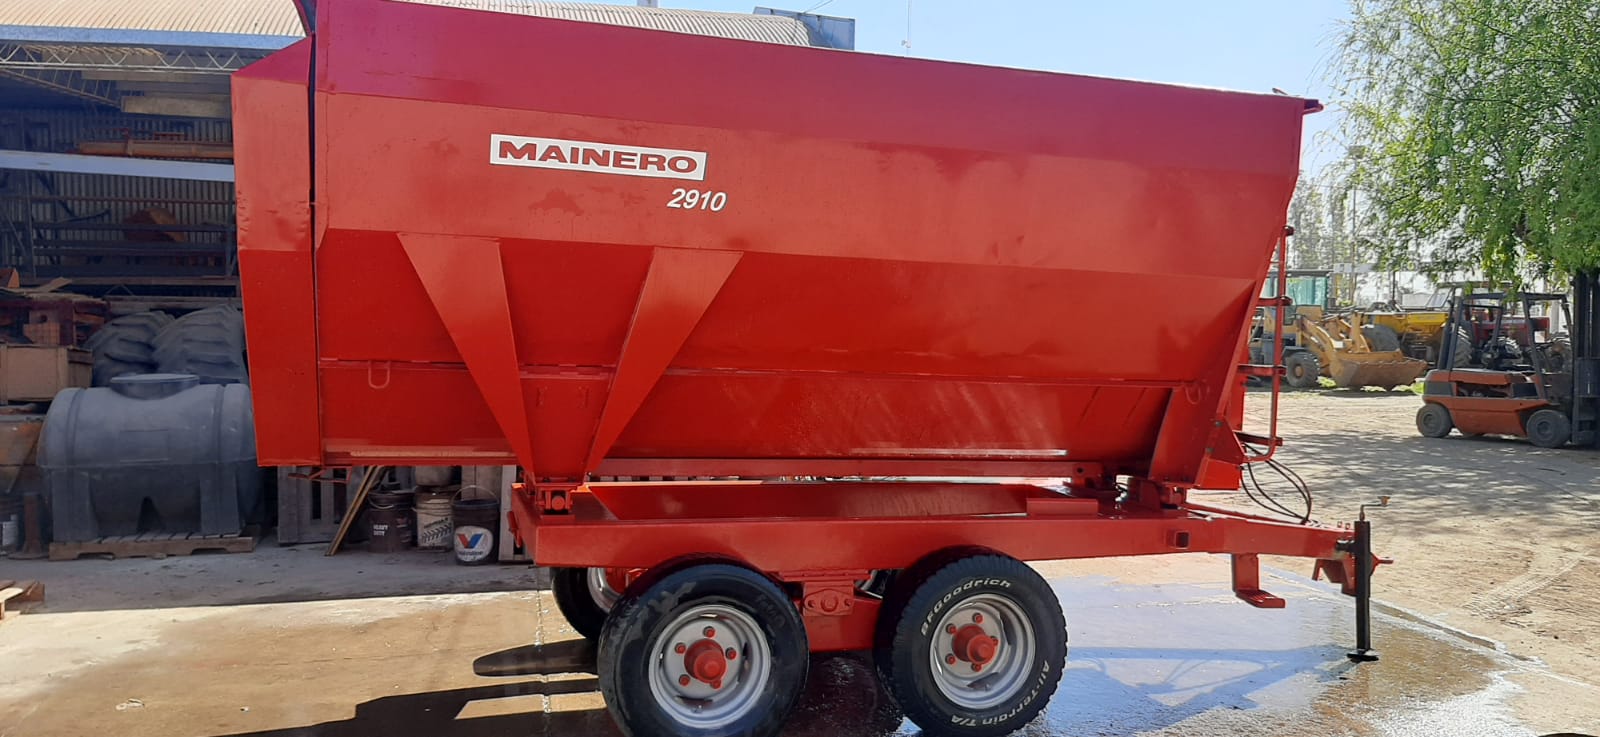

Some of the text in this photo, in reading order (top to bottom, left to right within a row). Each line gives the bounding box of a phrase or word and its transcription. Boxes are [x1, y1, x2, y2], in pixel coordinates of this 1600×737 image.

[498, 140, 698, 174] MAINERO
[667, 187, 728, 212] 2910
[921, 577, 1012, 636] BFGoodrich
[951, 660, 1050, 727] All-Terrain T/A
